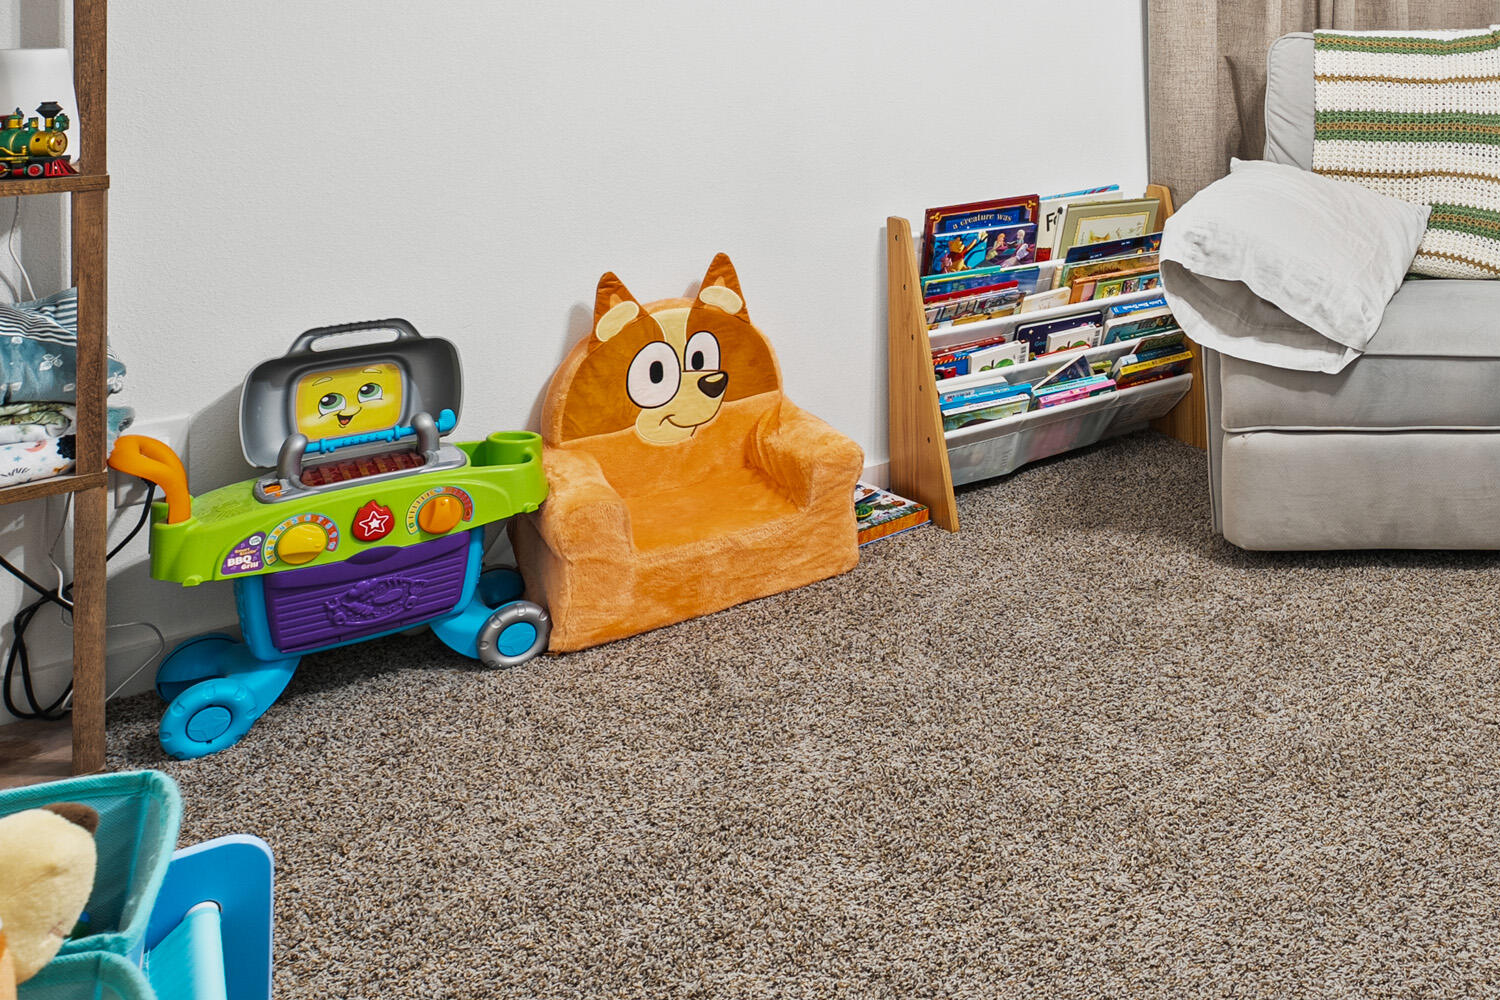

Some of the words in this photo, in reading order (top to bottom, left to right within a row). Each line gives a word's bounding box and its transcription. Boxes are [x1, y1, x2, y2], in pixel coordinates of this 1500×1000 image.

[960, 214, 995, 226] creature
[997, 213, 1013, 222] was
[227, 555, 252, 567] BBQ
[241, 561, 259, 570] Grill
